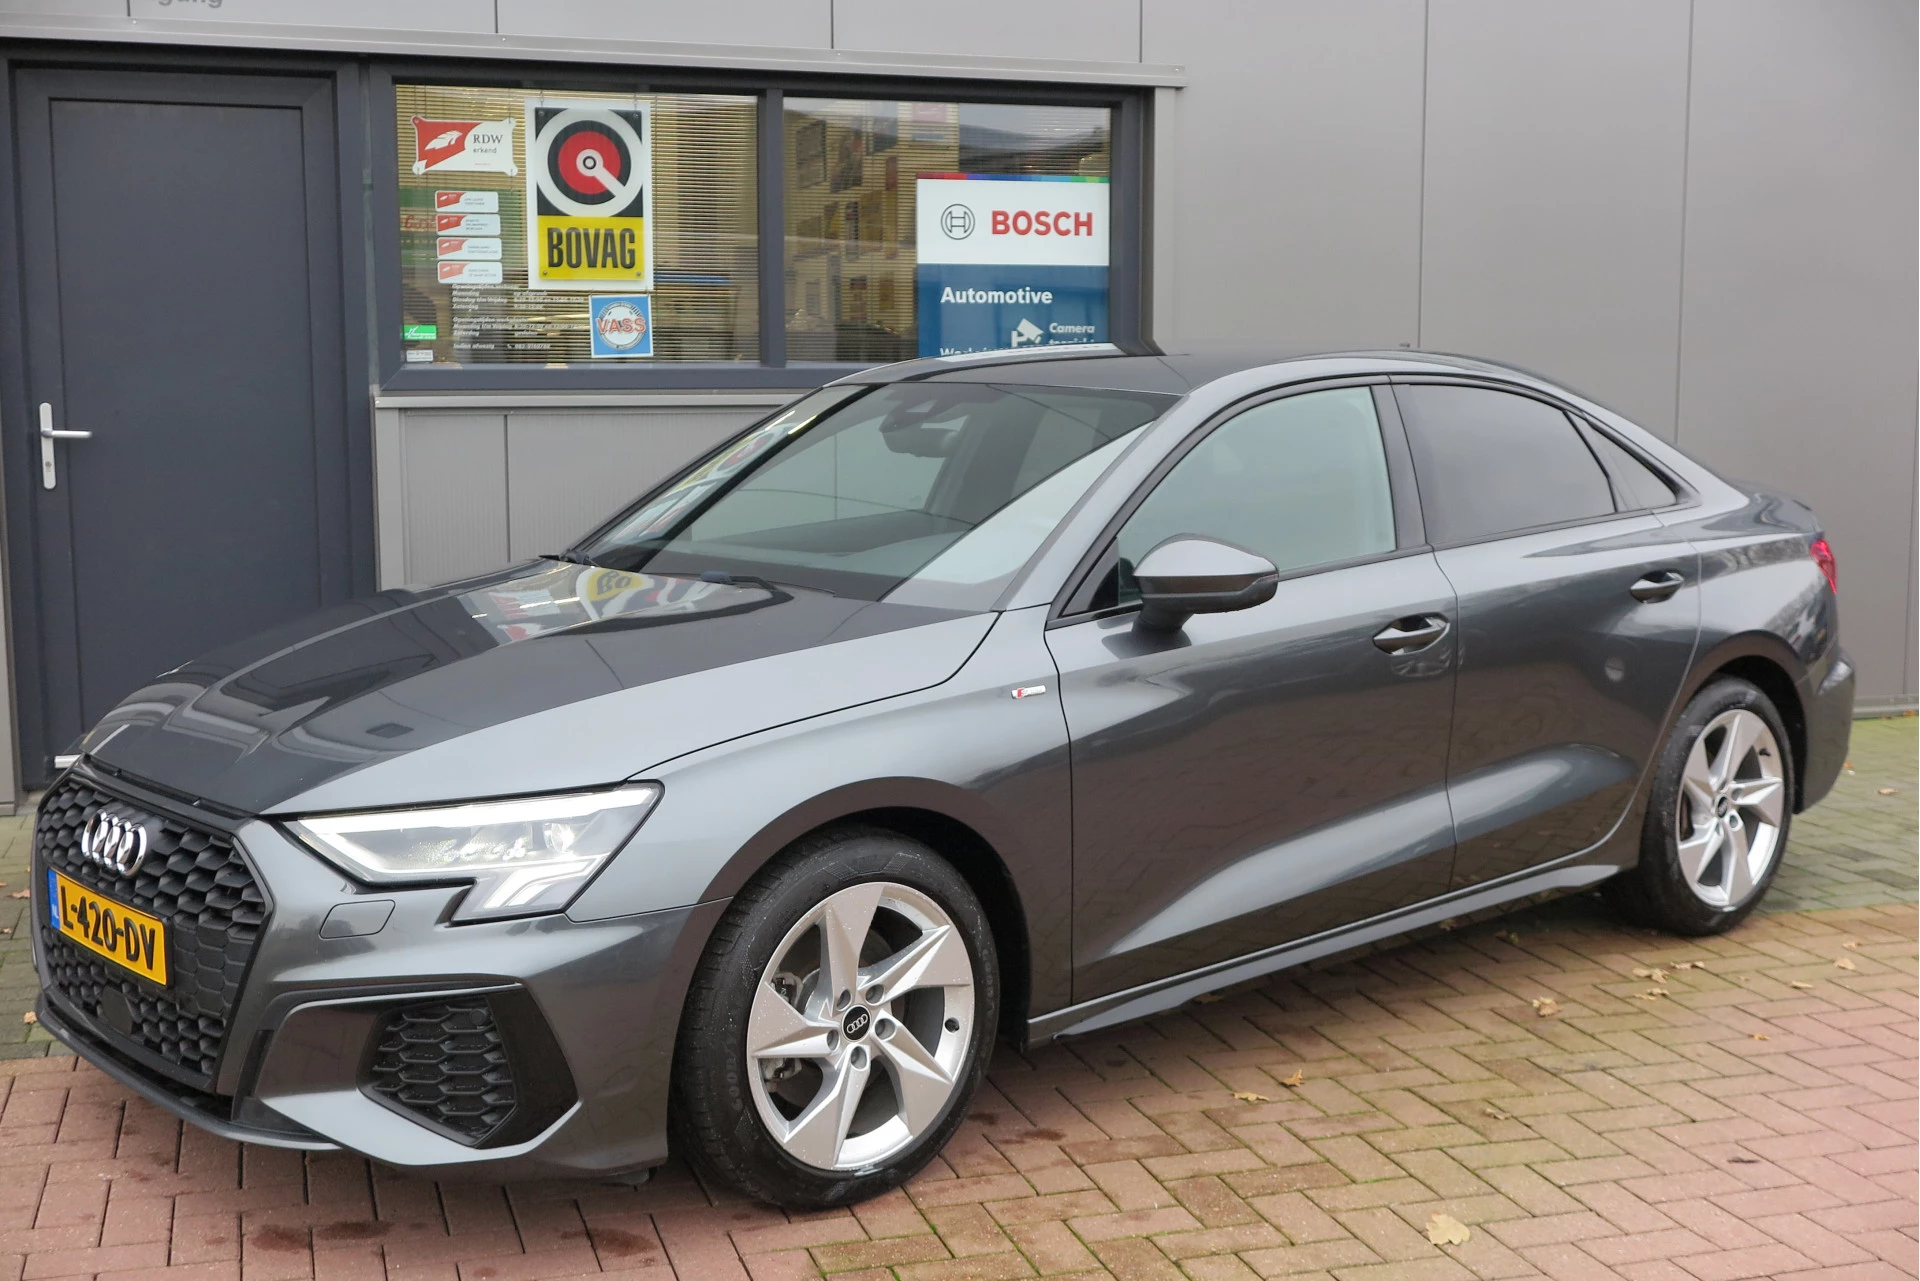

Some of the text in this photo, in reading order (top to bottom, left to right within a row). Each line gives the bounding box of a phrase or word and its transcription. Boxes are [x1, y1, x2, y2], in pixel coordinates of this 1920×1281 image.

[473, 134, 503, 144] RDW
[991, 210, 1093, 237] BOSCH
[547, 227, 636, 269] BOVAG
[940, 287, 1053, 304] Automotive
[596, 317, 647, 334] VASS
[1049, 322, 1095, 334] Camera
[60, 885, 156, 971] L-420-DV
